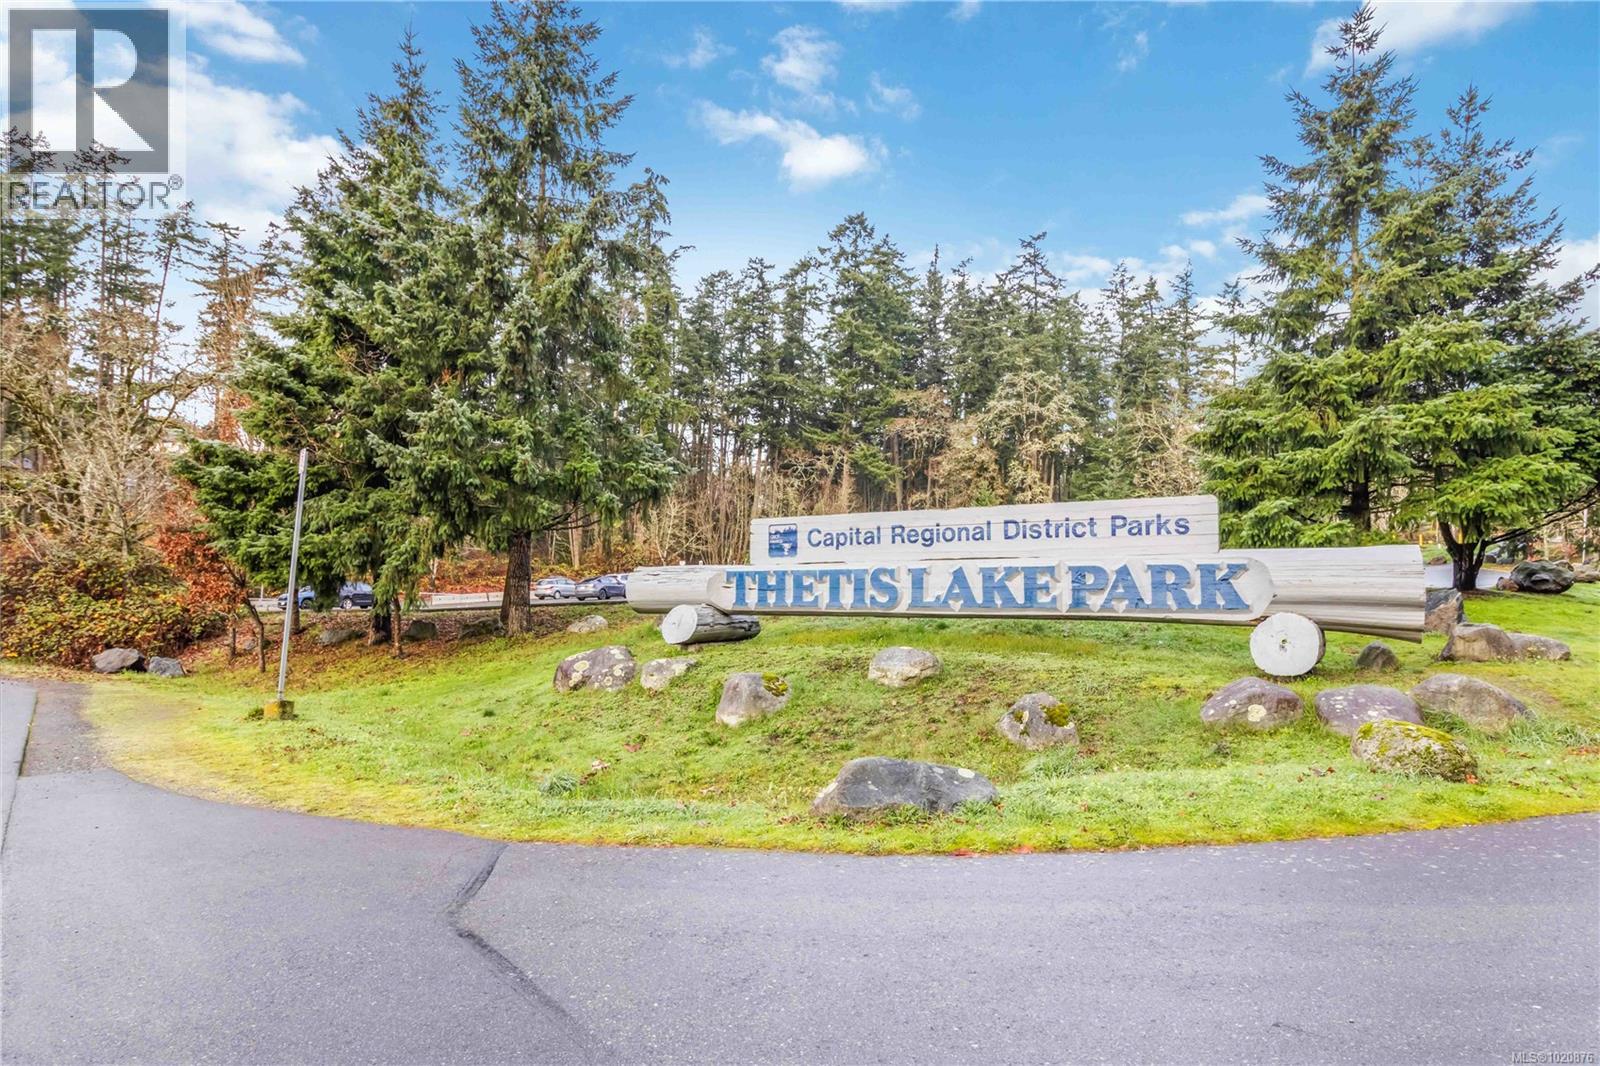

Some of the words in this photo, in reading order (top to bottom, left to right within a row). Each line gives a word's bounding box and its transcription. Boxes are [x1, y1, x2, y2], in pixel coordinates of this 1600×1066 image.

[807, 526, 881, 550] Capital
[891, 520, 992, 547] Regional
[1003, 516, 1097, 540] District
[1110, 513, 1190, 537] Parks
[725, 567, 897, 610] THETIS
[907, 566, 1060, 610] LAKE
[1066, 563, 1250, 610] PARK
